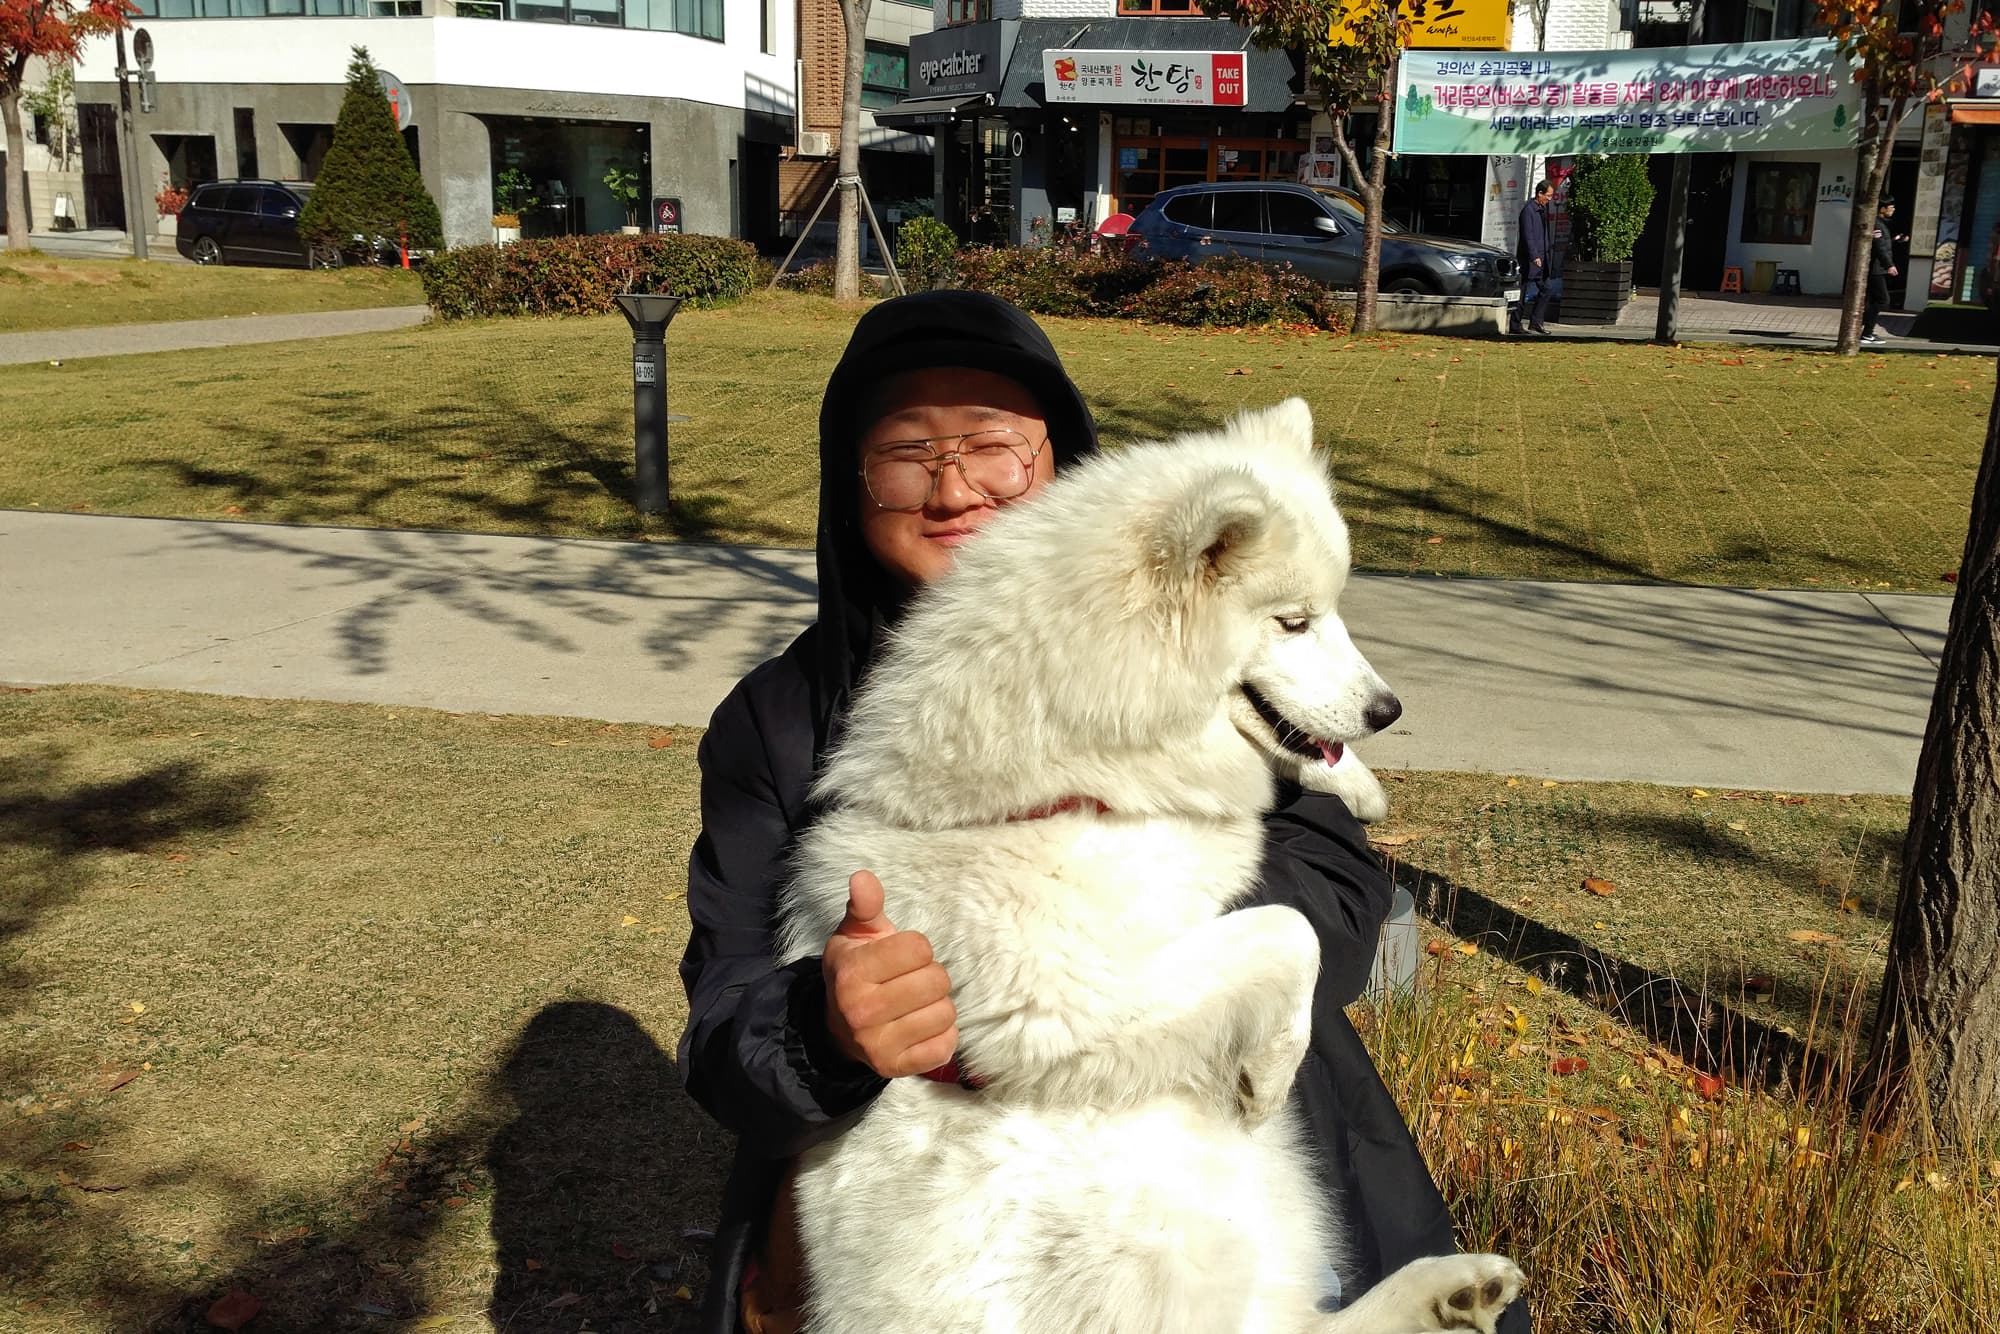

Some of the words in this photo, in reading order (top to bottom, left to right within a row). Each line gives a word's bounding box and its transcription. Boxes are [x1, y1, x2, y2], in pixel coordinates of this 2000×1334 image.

[919, 59, 938, 86] eye
[939, 48, 981, 78] catcher
[1216, 68, 1240, 79] TAKE
[1436, 60, 1475, 76] 경의선
[1479, 60, 1533, 76] 숲길공원
[1537, 60, 1551, 75] 내
[1131, 62, 1194, 93] 한탕
[1219, 83, 1240, 94] OUT
[1434, 83, 1543, 108] 거리공연(버스킹
[1572, 83, 1619, 106] 활동을
[1623, 81, 1654, 104] 저녁
[1659, 80, 1686, 102] 8시
[1691, 77, 1739, 101] 이후에
[1489, 116, 1516, 131] 시민
[1520, 115, 1575, 130] 여러분의
[1579, 115, 1634, 130] 적극적인
[1639, 112, 1668, 128] 협조
